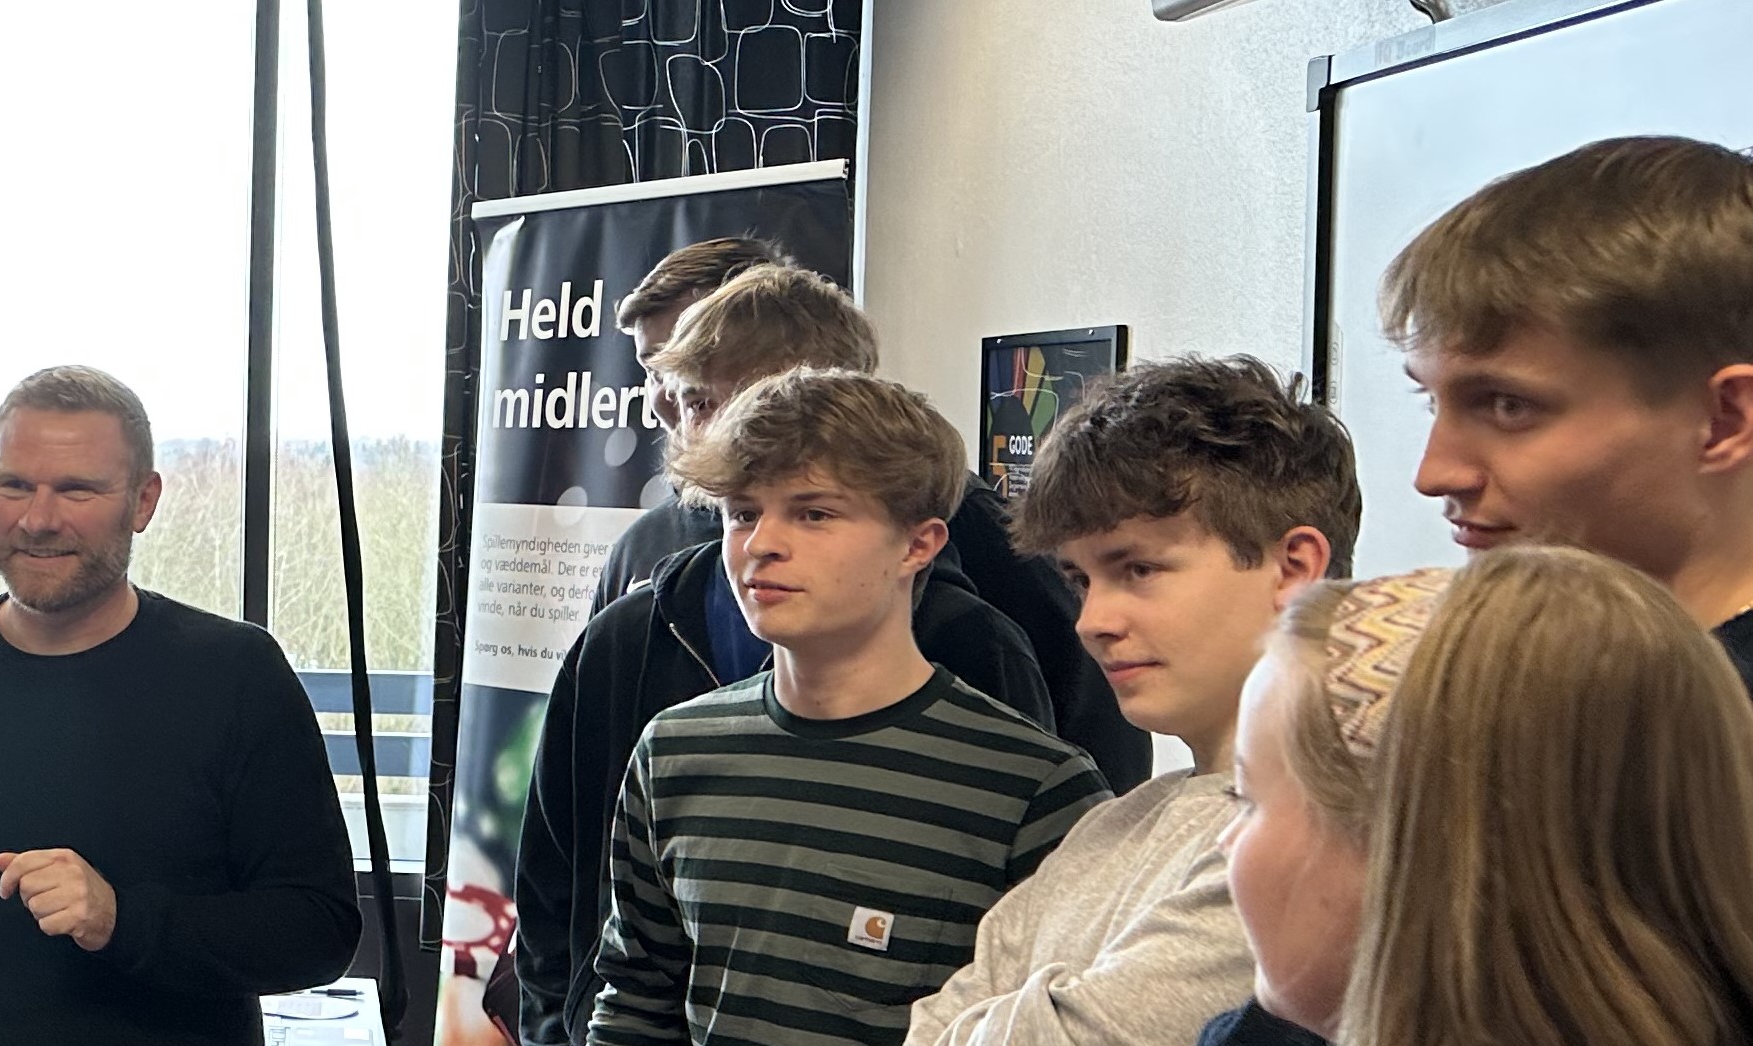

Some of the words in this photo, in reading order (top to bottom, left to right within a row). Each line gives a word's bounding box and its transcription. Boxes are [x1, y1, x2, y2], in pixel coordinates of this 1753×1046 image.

[500, 279, 604, 341] Held
[492, 371, 665, 430] midlert
[1009, 435, 1033, 456] GODE
[482, 534, 581, 556] Spillemyndigheden
[583, 543, 609, 559] giver
[480, 558, 493, 574] og
[558, 560, 577, 576] Der
[579, 566, 590, 577] er
[478, 577, 495, 593] alle
[496, 581, 547, 599] varianter,
[550, 585, 565, 602] og
[568, 584, 596, 601] derfo
[508, 601, 527, 617] når
[530, 603, 545, 619] du
[475, 639, 498, 657] Spørg
[500, 645, 514, 658] os,
[517, 643, 537, 659] hvis
[540, 647, 554, 660] du
